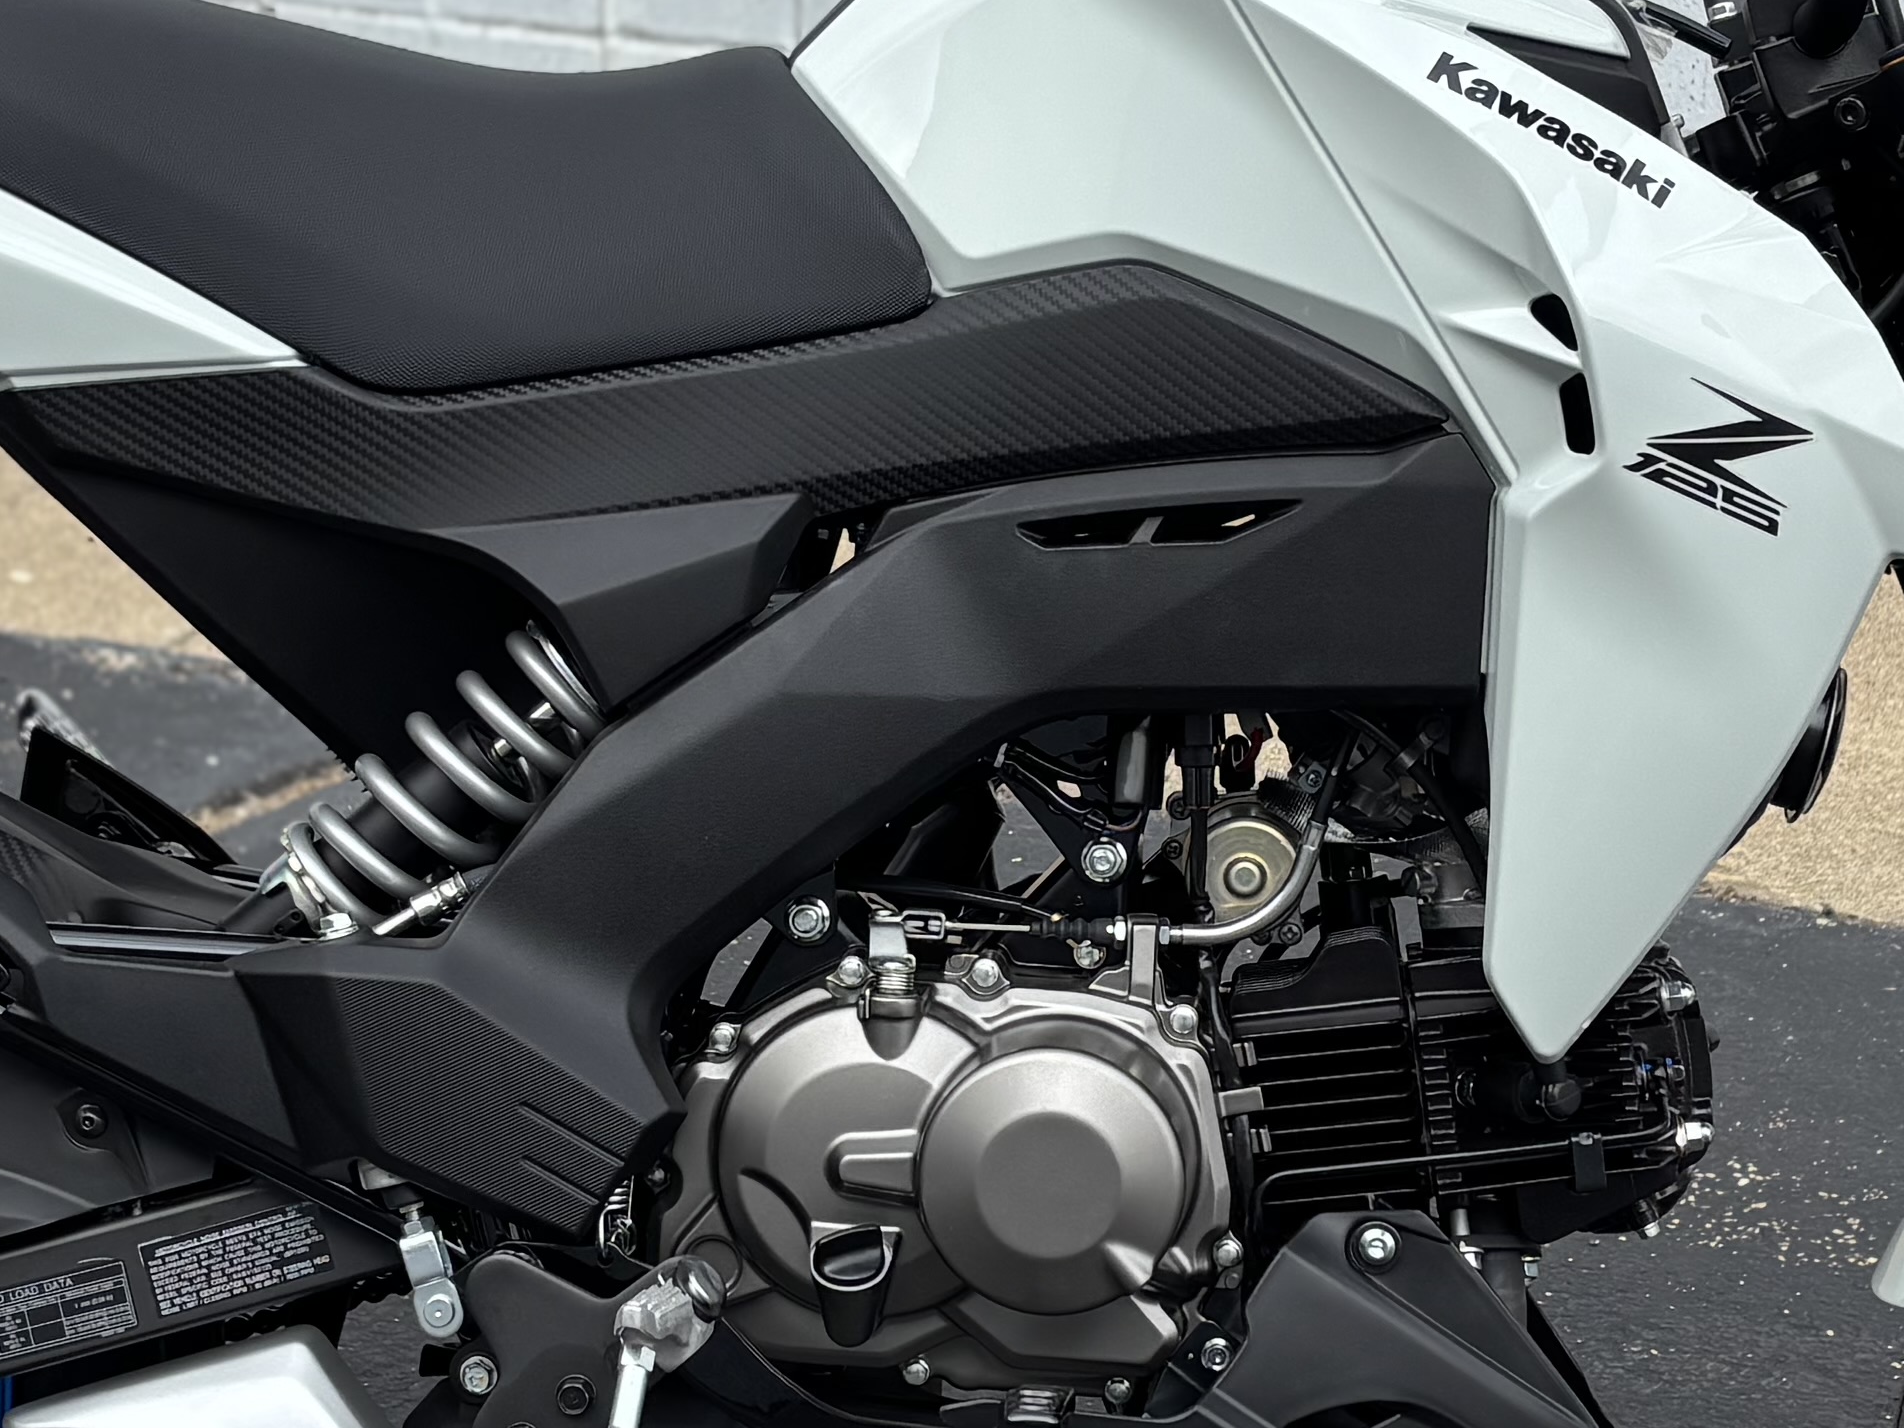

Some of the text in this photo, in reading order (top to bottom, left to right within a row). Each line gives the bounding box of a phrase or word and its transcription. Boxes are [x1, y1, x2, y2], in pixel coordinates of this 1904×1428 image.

[1426, 52, 1676, 209] Kawasaki
[1622, 451, 1779, 537] 125
[1647, 377, 1814, 509] Z
[8, 1284, 40, 1301] LOAD
[42, 1276, 74, 1293] DATA
